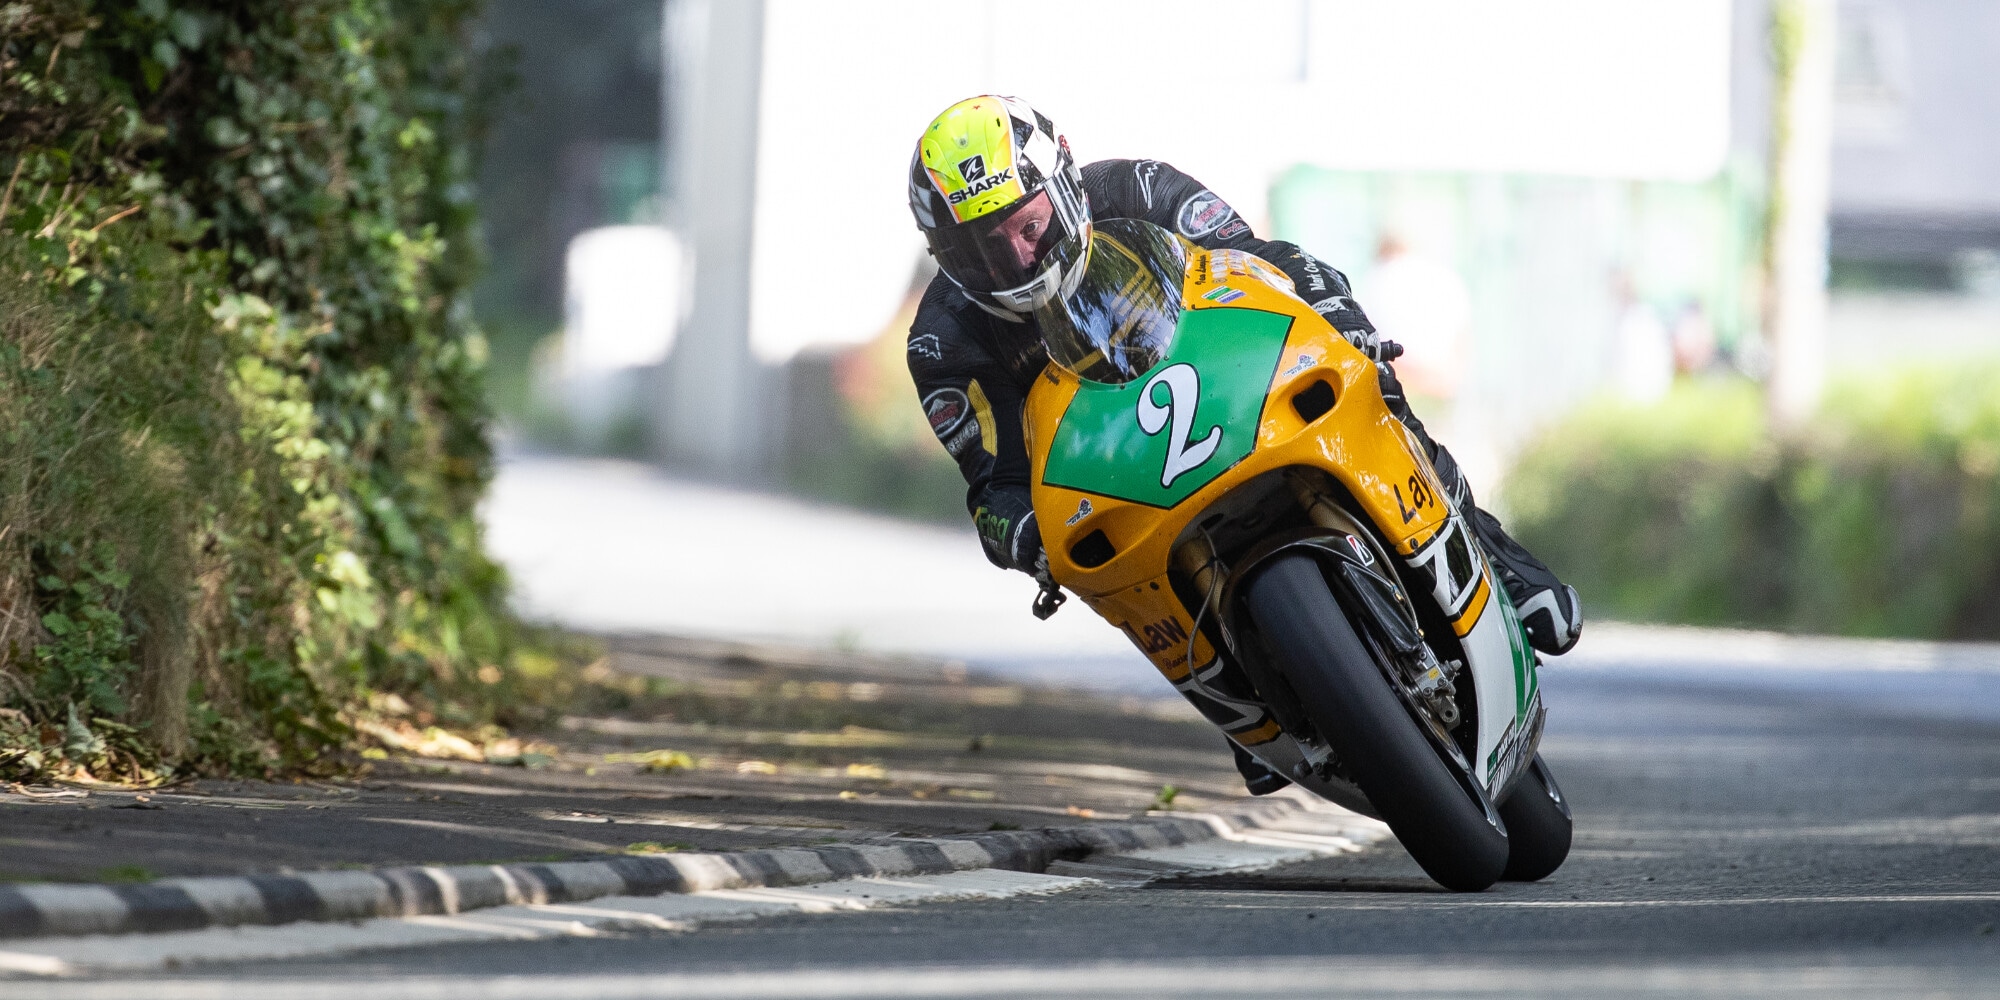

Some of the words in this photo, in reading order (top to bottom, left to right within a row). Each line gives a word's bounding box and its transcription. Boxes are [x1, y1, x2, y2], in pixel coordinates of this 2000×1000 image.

[948, 167, 1013, 204] SHARK
[1136, 362, 1223, 489] 2
[1393, 469, 1434, 525] Lay
[1119, 614, 1189, 655] Law
